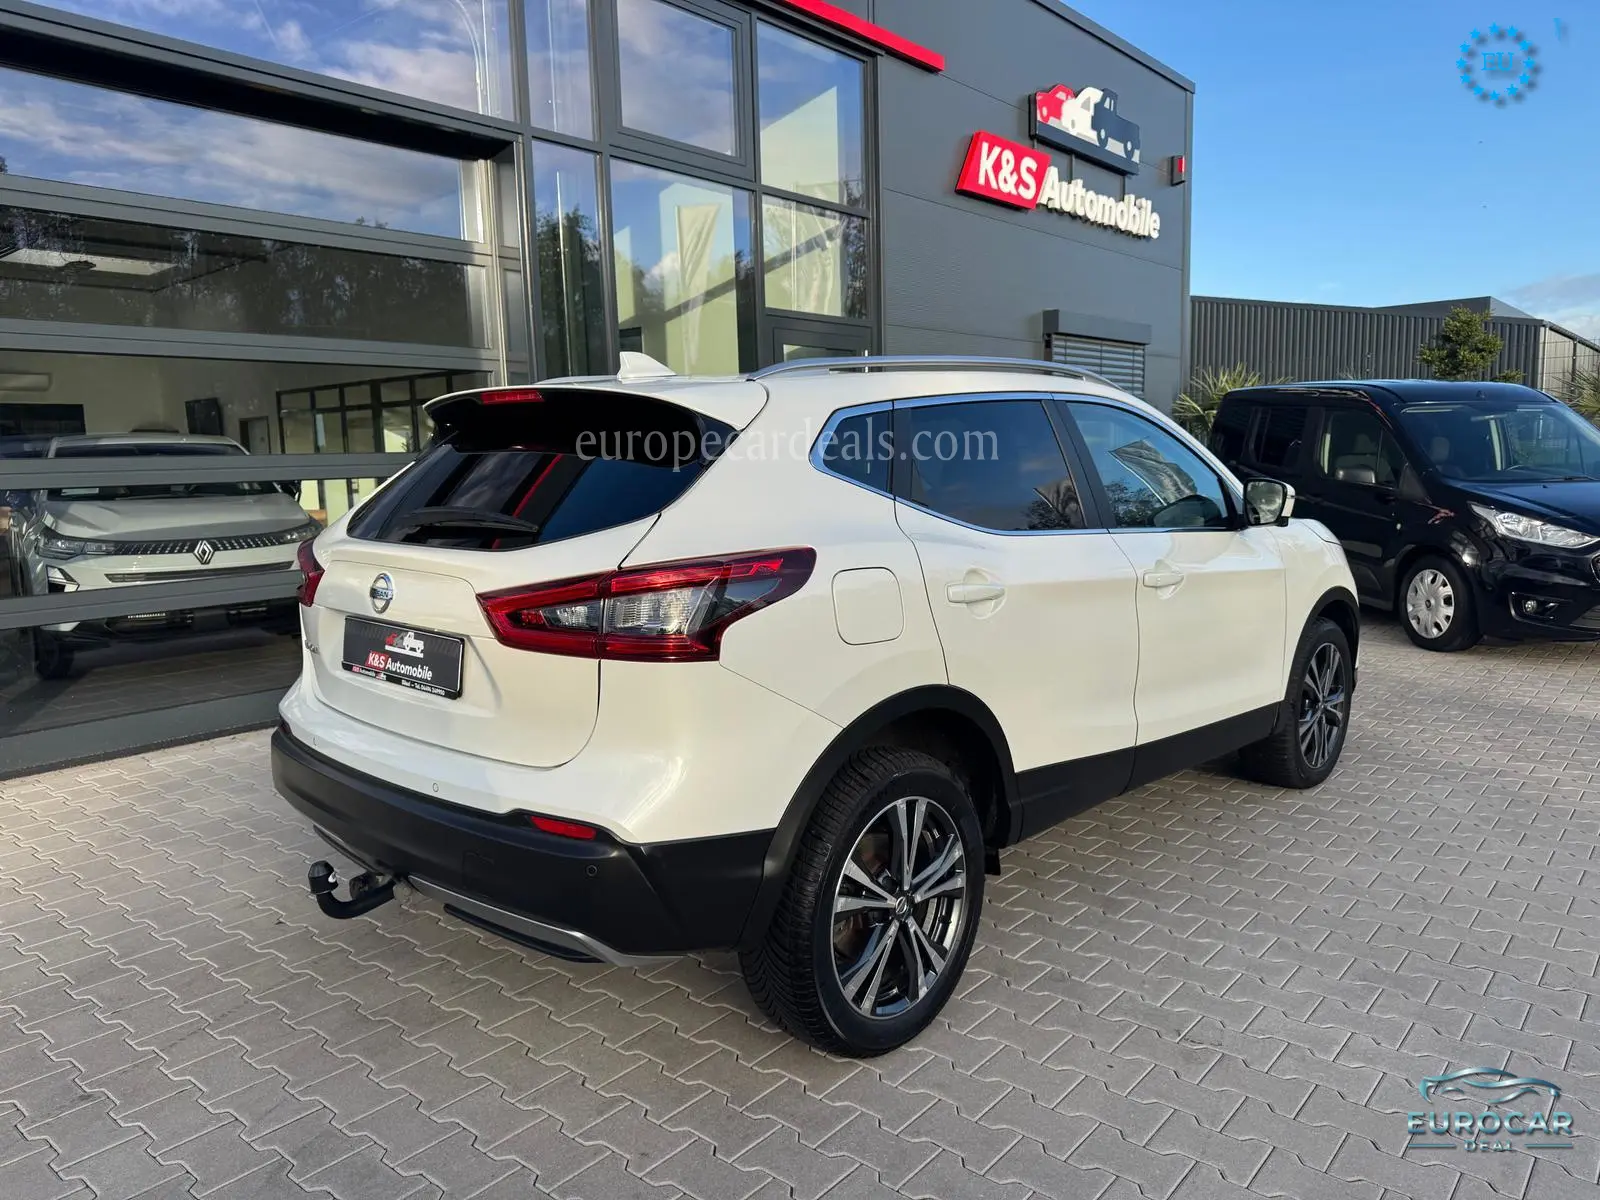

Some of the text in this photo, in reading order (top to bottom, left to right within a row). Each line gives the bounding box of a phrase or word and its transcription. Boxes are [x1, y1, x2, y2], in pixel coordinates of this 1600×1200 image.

[977, 141, 1161, 239] K&S Automobile
[367, 652, 433, 680] K&S Automobile
